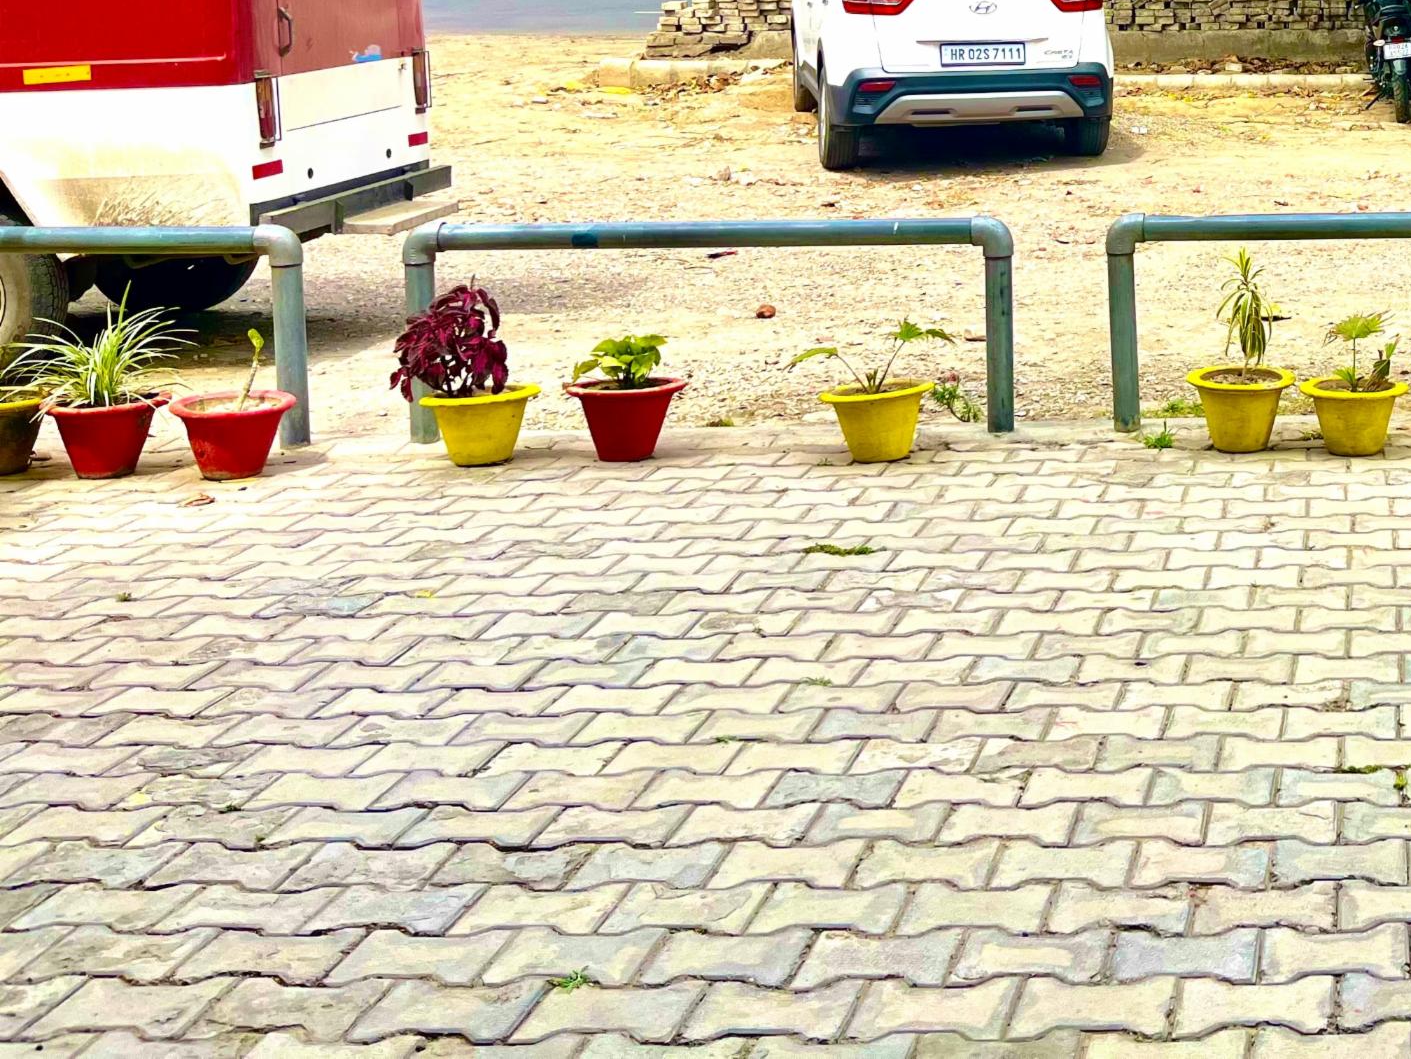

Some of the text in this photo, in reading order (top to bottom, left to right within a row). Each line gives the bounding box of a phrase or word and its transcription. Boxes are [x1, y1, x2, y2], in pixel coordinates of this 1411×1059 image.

[950, 47, 1021, 60] HR 02S 7111
